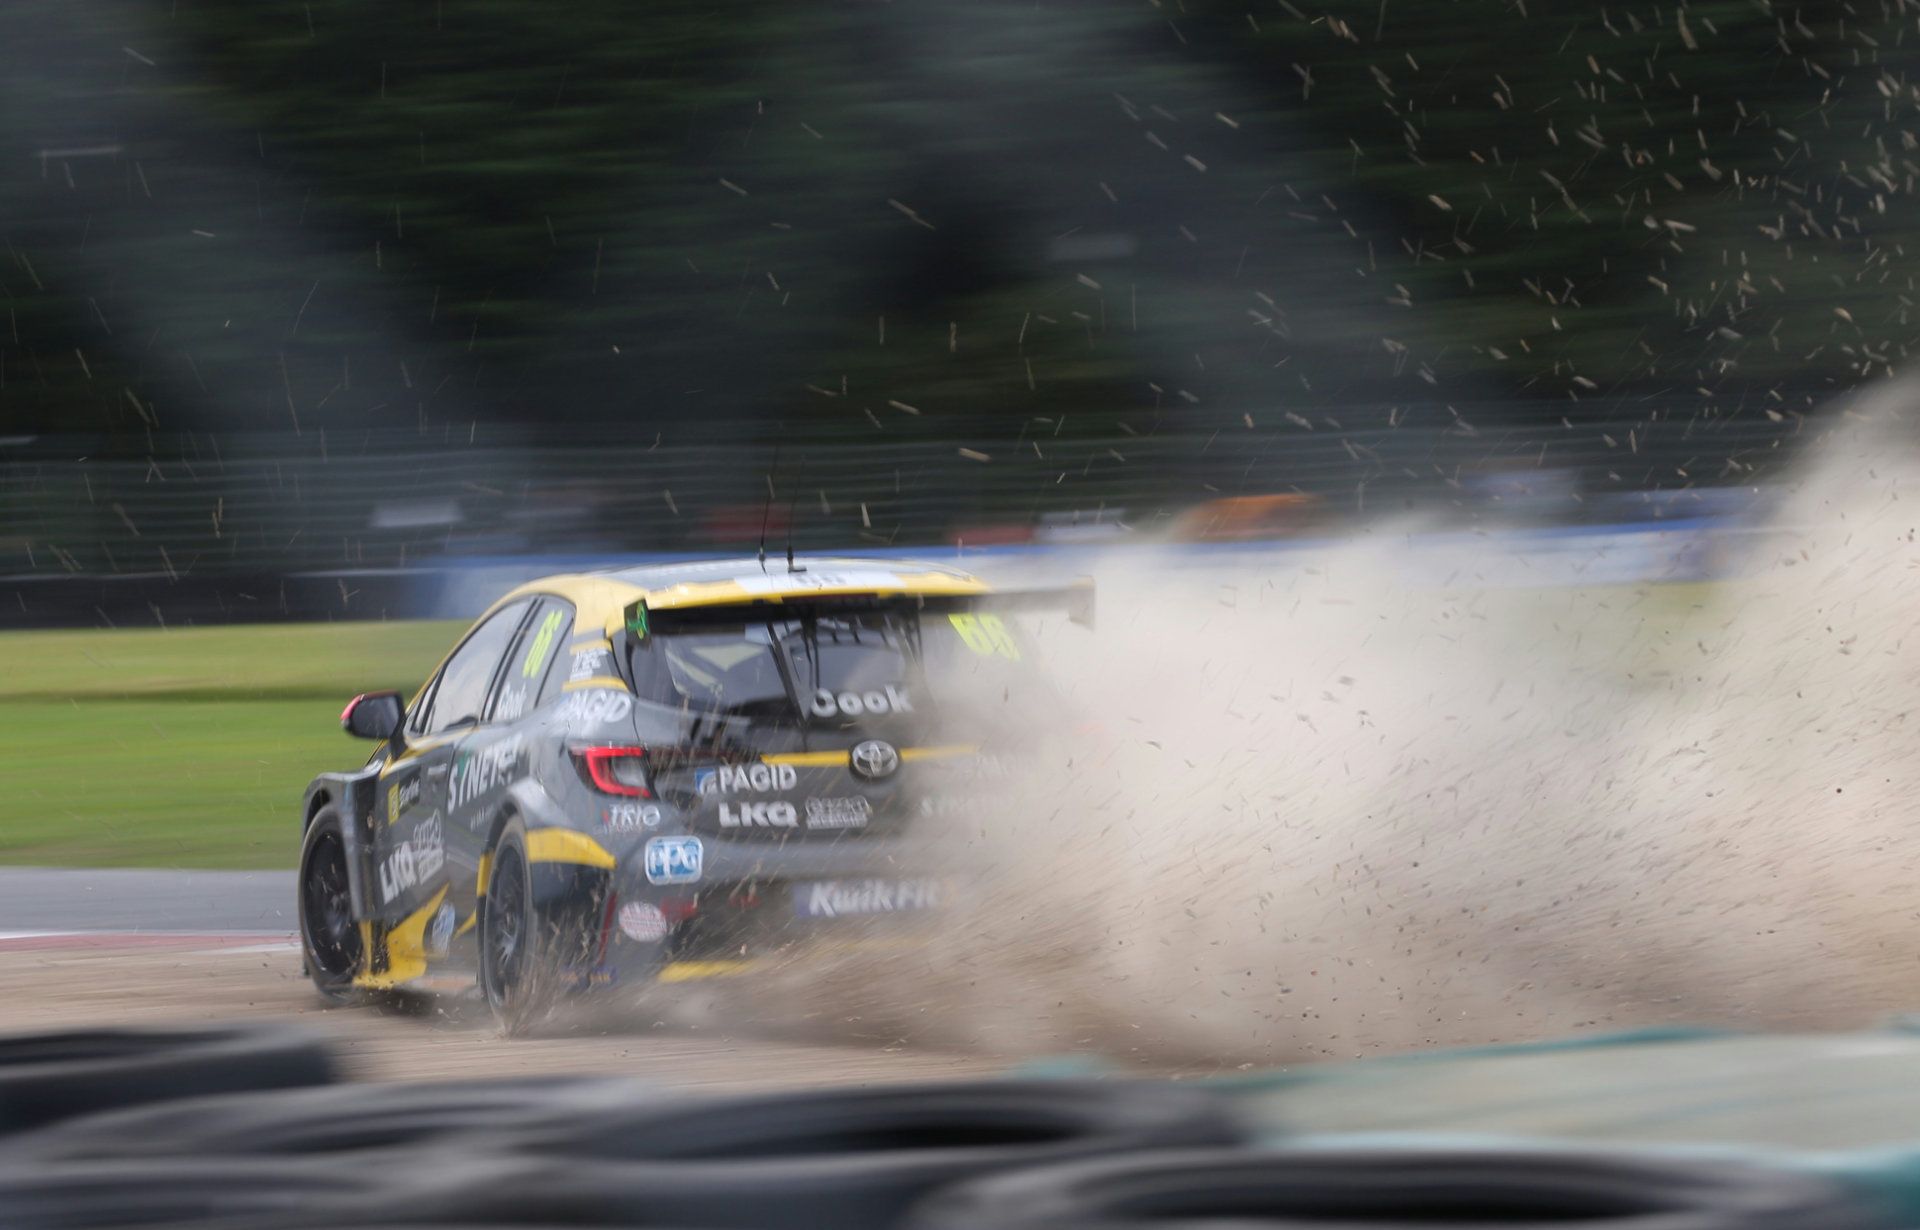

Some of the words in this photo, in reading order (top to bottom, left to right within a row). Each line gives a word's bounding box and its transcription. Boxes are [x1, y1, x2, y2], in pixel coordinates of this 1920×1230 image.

[811, 684, 915, 717] Cook
[719, 763, 798, 793] PAGID
[719, 801, 800, 828] LKQ
[380, 840, 417, 905] LKQ
